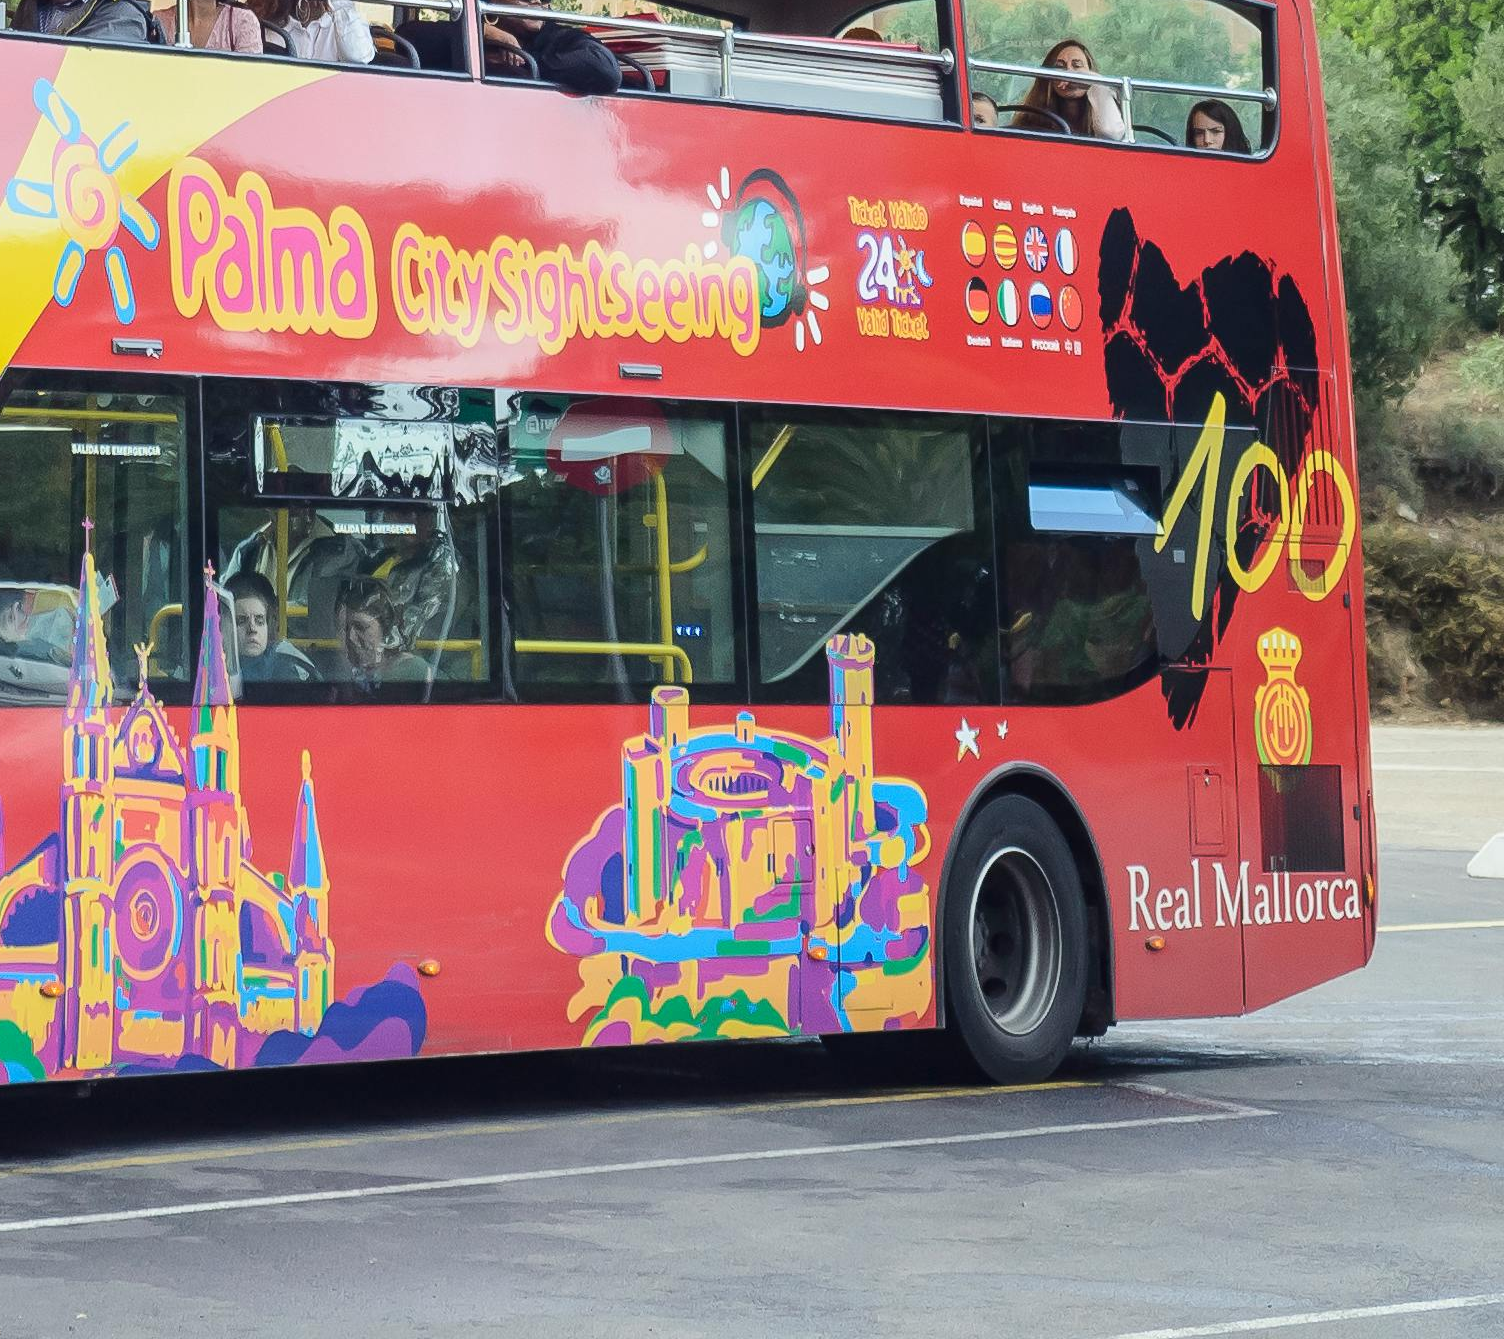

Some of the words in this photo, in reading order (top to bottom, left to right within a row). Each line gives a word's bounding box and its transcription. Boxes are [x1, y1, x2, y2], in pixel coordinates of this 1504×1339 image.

[847, 195, 888, 229] Ticket
[167, 156, 377, 340] Palma
[857, 232, 899, 302] 24
[856, 306, 890, 337] Valid
[890, 308, 930, 341] Ticket
[71, 442, 99, 455] SALIDA
[100, 443, 111, 456] DE
[111, 444, 161, 457] EMERGENCIA
[334, 523, 360, 534] SALIDA
[361, 523, 371, 534] DE
[371, 523, 417, 535] EMERGENCIA
[1153, 390, 1357, 621] 100
[1125, 858, 1203, 931] Real
[1211, 856, 1362, 928] Mallorca
